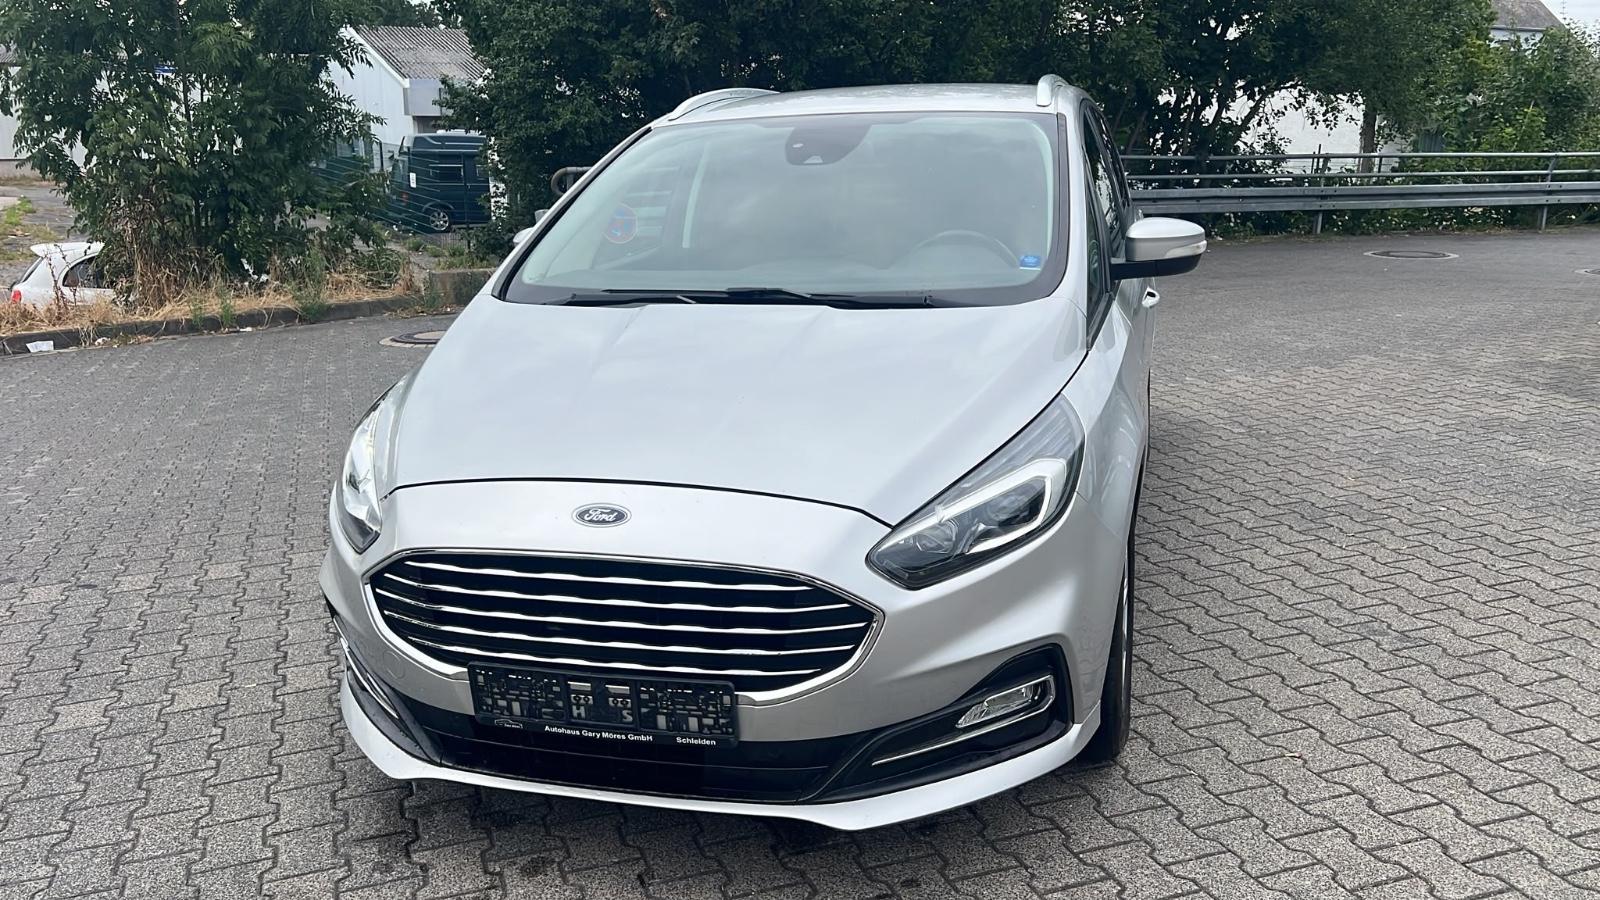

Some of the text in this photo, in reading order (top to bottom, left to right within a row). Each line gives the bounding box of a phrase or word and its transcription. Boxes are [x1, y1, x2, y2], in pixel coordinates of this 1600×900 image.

[584, 508, 618, 521] Ford
[544, 725, 580, 736] Autohaus
[582, 730, 601, 739] Gary
[627, 734, 653, 742] GmbH
